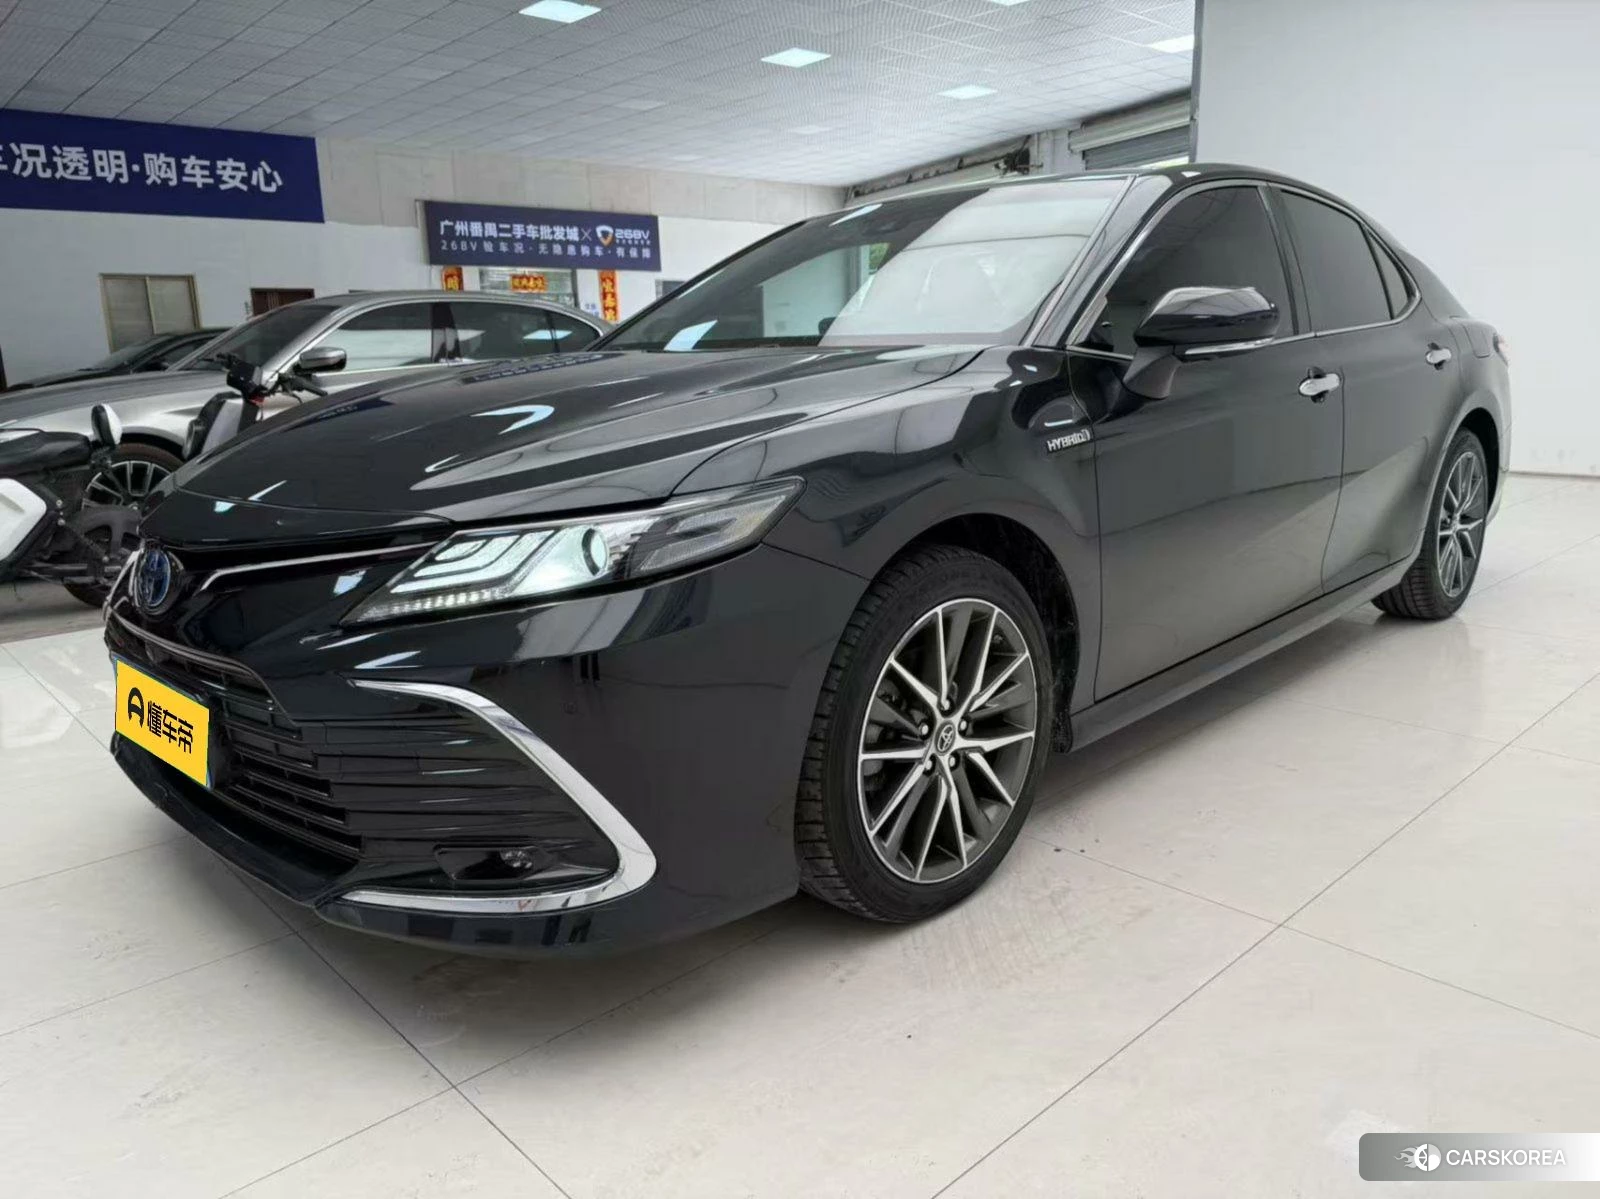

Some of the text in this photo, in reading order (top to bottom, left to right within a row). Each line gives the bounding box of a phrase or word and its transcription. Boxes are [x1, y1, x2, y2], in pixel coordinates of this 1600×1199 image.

[440, 219, 579, 241] 广州番禺二手车批发城
[1047, 431, 1086, 452] HYBRID
